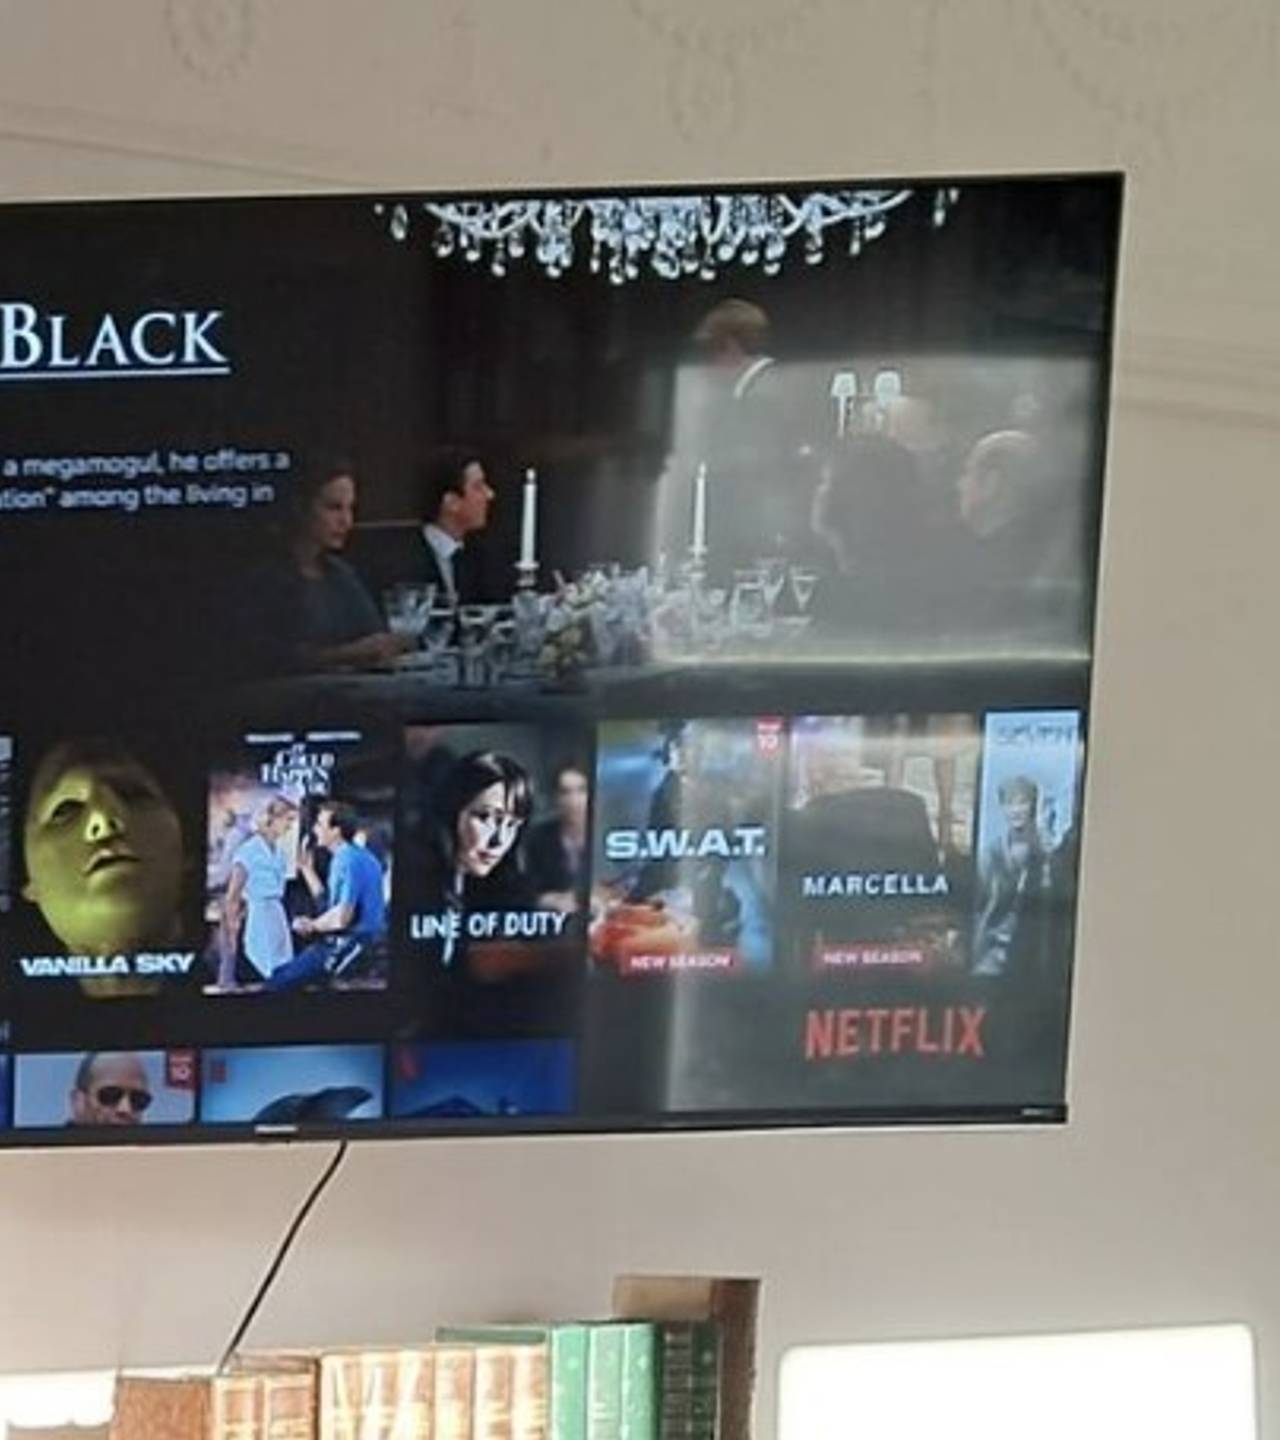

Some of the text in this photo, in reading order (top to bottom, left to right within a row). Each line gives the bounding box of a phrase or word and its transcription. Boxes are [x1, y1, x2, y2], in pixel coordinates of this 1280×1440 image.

[3, 459, 19, 476] a
[22, 451, 165, 480] megamogul,
[169, 450, 199, 471] he
[203, 447, 272, 471] offers
[274, 451, 290, 469] a
[59, 488, 140, 513] among
[143, 483, 182, 506] the
[185, 483, 248, 509] living
[251, 482, 275, 503] in
[605, 827, 767, 860] S.W.A.T.
[802, 874, 949, 897] MARCELLA
[409, 910, 568, 939] LINE OF DUTY
[20, 952, 197, 977] VANILLA SKY
[805, 1005, 987, 1060] NETFLIX
